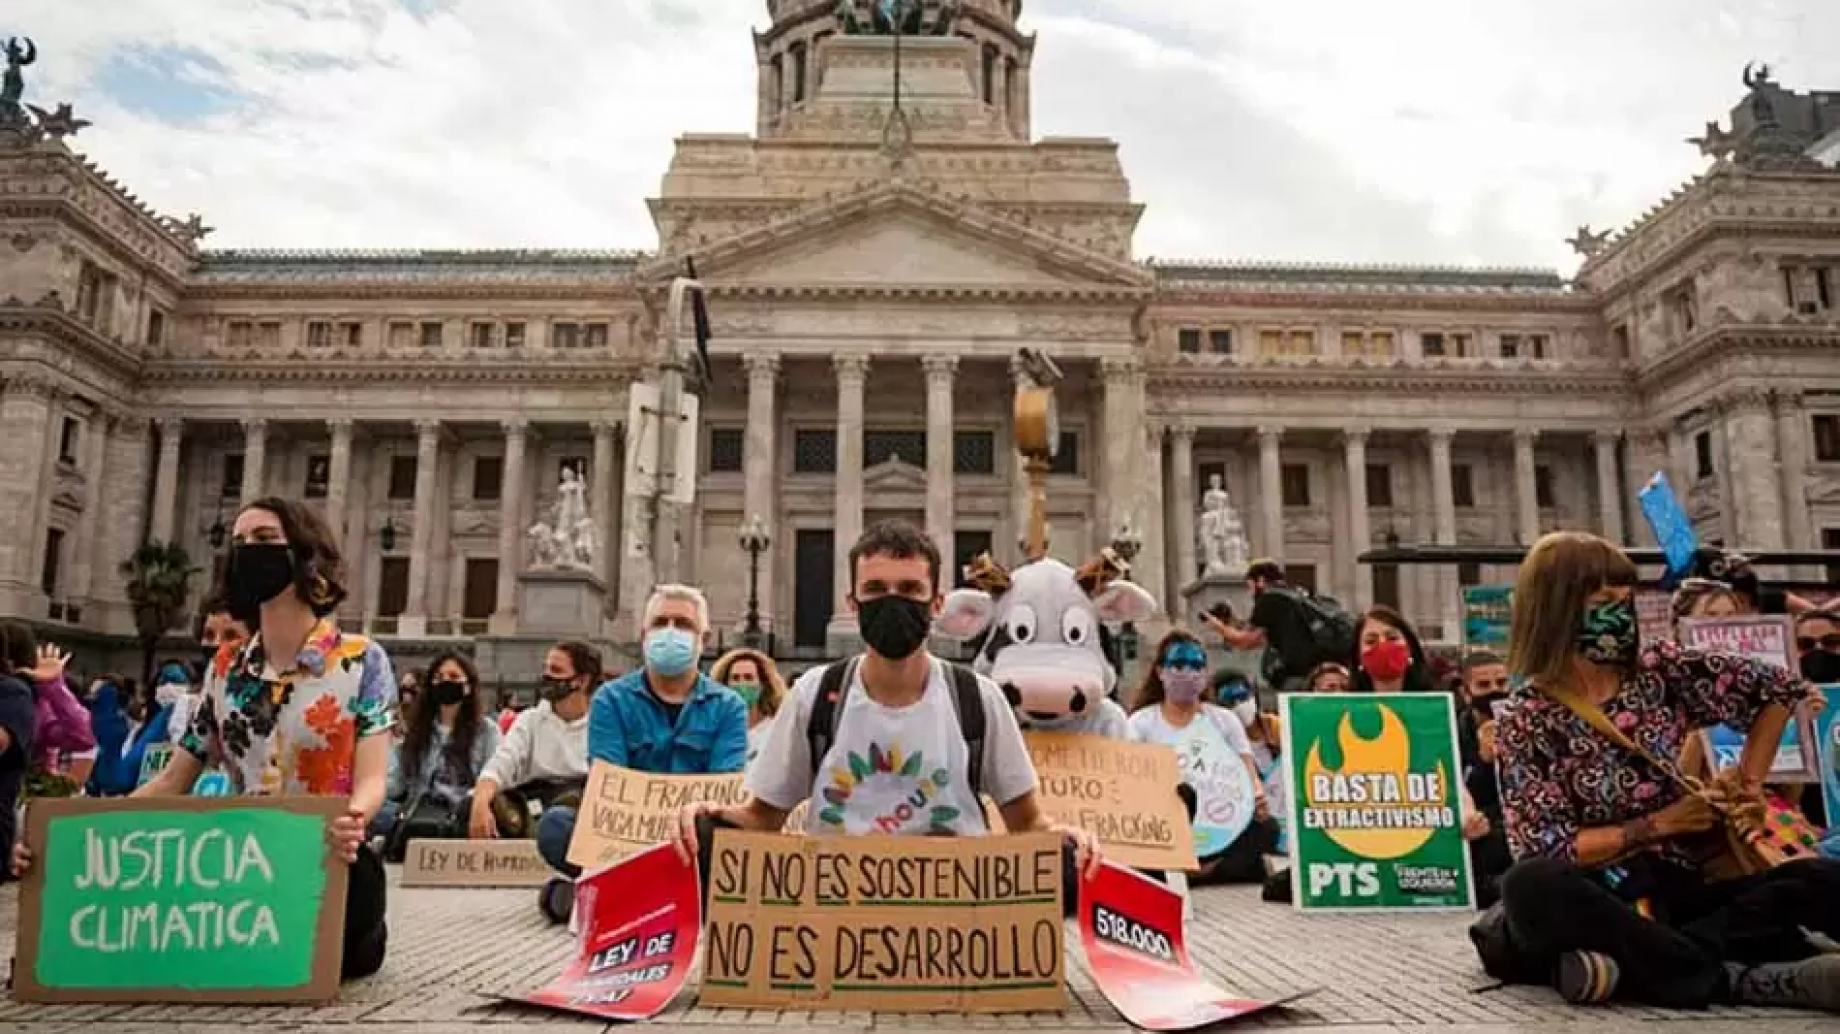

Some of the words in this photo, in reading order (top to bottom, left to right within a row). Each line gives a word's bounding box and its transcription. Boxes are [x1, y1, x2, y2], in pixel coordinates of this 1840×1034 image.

[600, 772, 637, 805] EL
[644, 778, 750, 810] FRACKING
[1039, 775, 1103, 801] TURO
[1312, 773, 1401, 802] BASTA
[1407, 772, 1443, 802] DE
[1080, 809, 1173, 843] FRACKING
[1303, 806, 1455, 828] EXTRACTIVISMO
[74, 827, 274, 891] JUSTICIA
[418, 846, 450, 871] LEY
[456, 851, 479, 873] DE
[714, 849, 750, 895] SI
[760, 852, 807, 900] NO
[815, 853, 853, 900] ES
[857, 850, 1058, 900] SOSTENIBLE
[1308, 862, 1380, 896] PTS
[69, 900, 280, 951] CLIMATICA
[1096, 905, 1172, 959] 518.000
[588, 938, 637, 973] LEY
[643, 932, 674, 957] DE
[706, 921, 754, 978] NO
[769, 925, 819, 980] ES
[831, 918, 1058, 980] DESARROLLO
